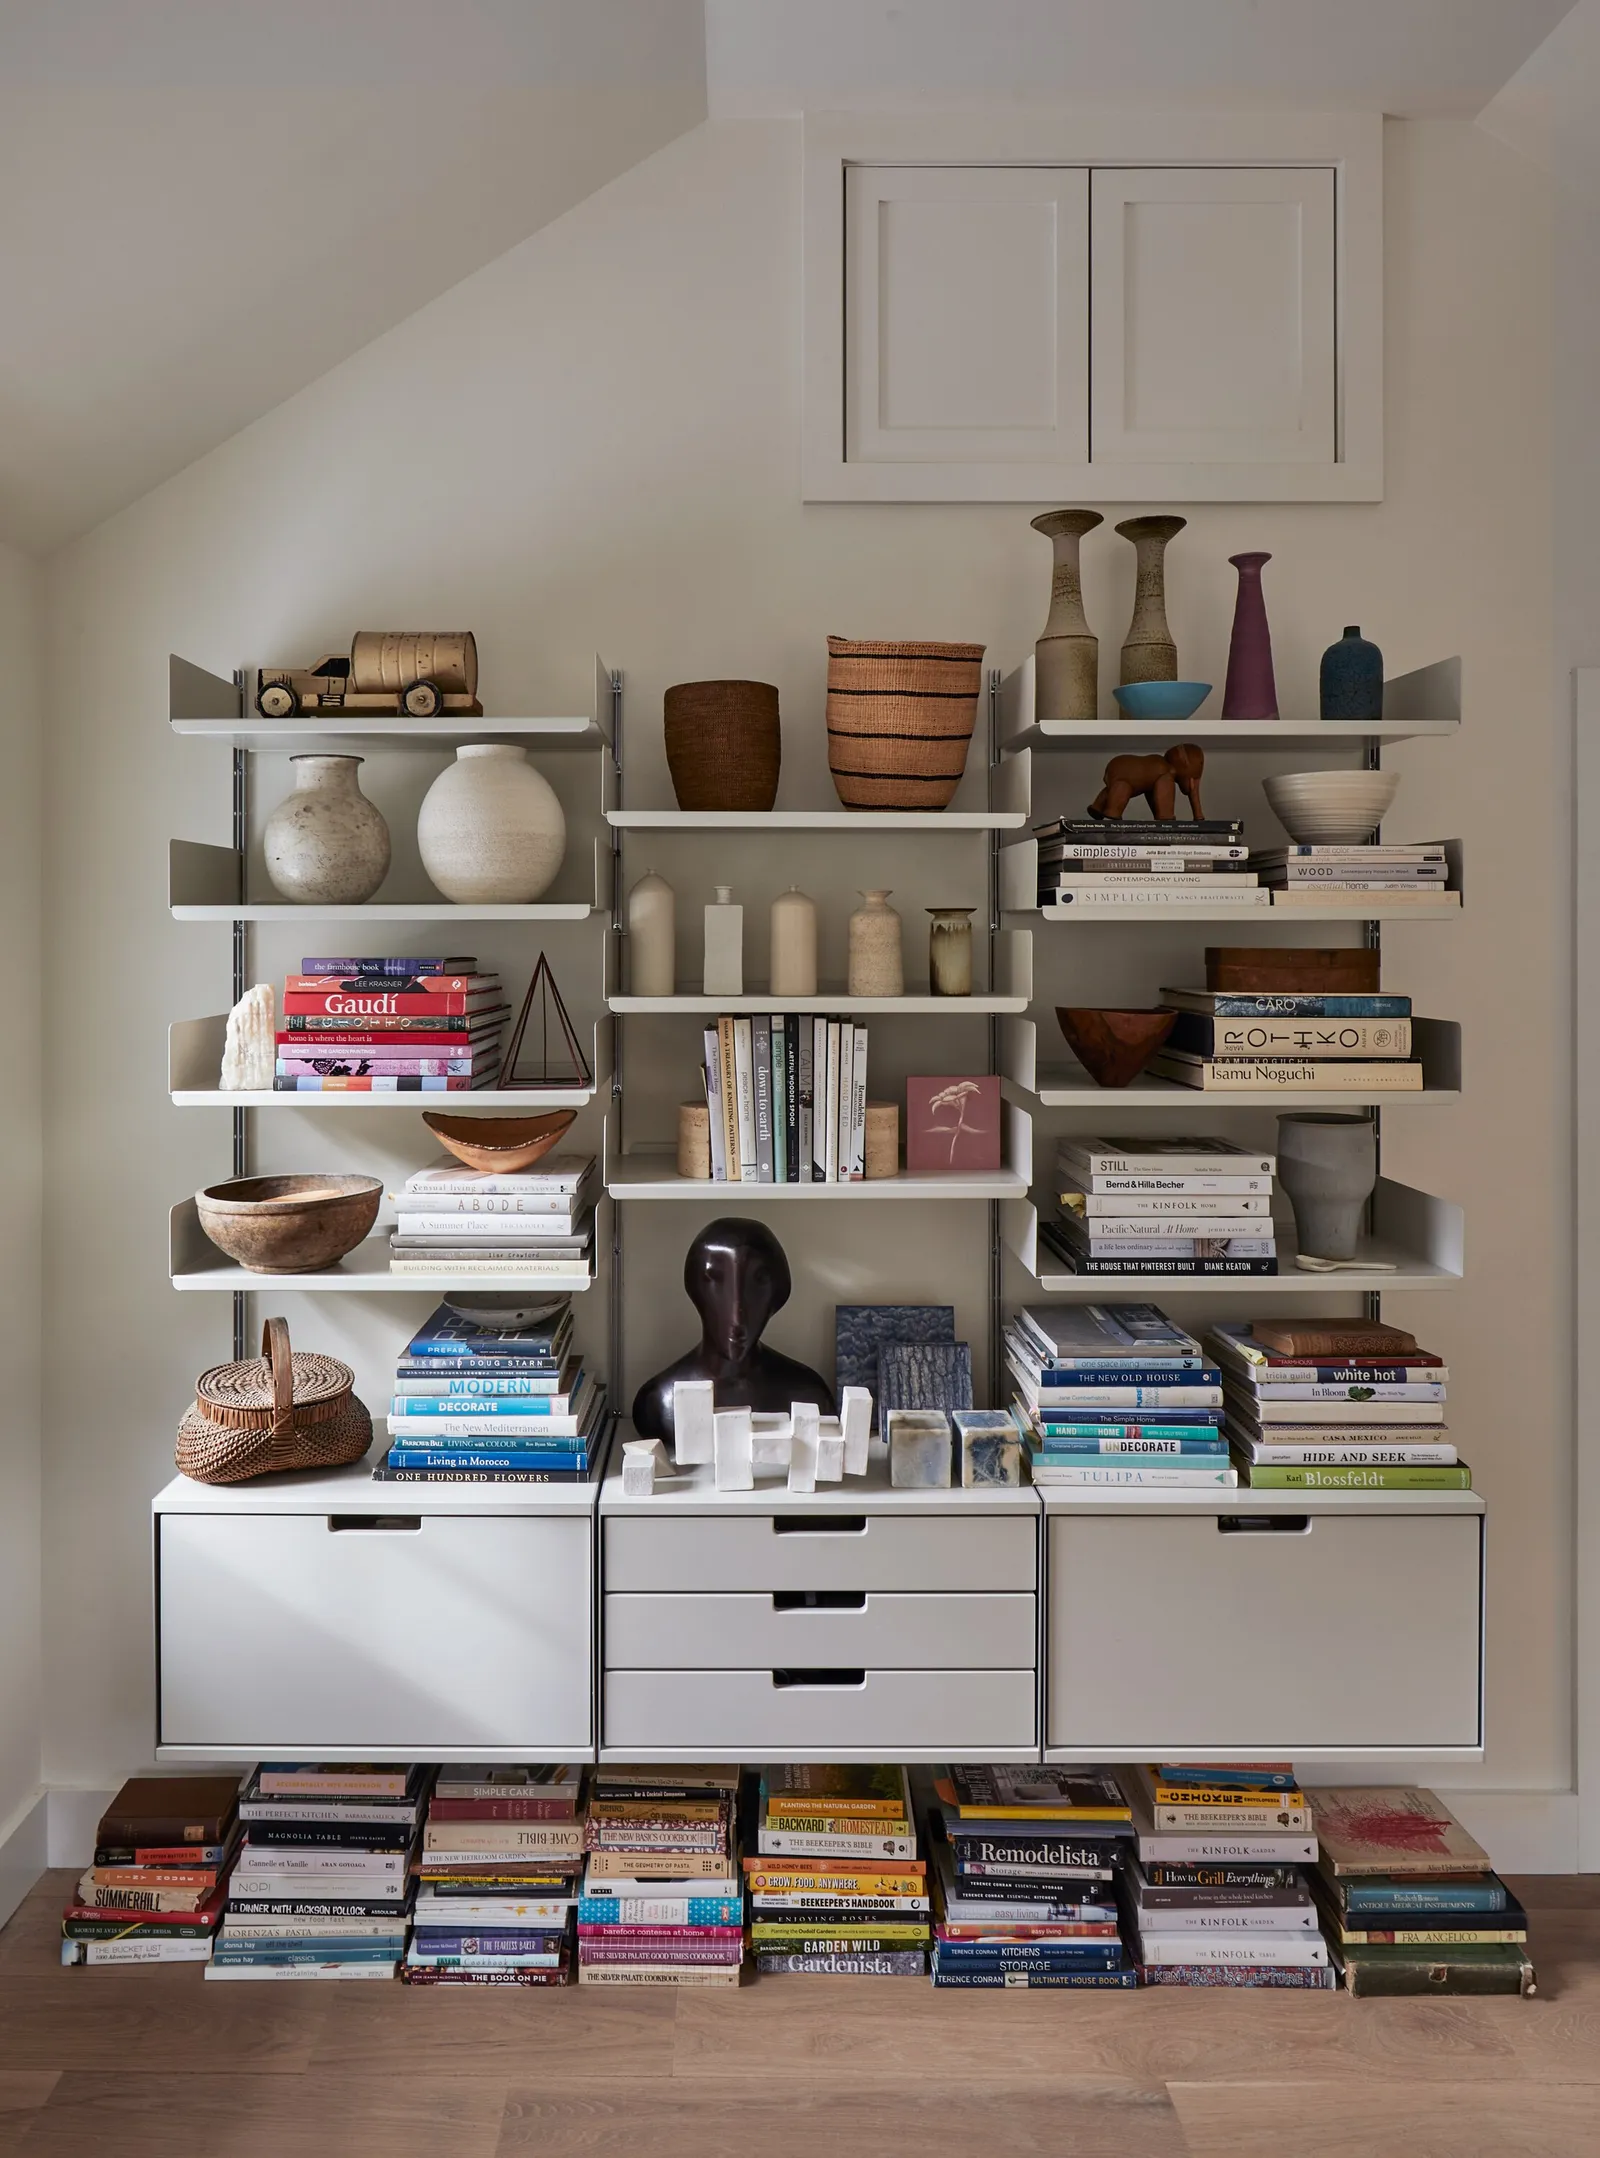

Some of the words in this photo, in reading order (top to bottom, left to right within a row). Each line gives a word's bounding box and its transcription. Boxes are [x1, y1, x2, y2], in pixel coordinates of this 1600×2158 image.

[1073, 847, 1137, 858] simplestyle
[1298, 868, 1333, 876] WOOD
[1085, 894, 1170, 902] SIMPLICITY
[325, 993, 399, 1013] Gaudí
[1255, 999, 1296, 1012] CARO
[800, 1048, 811, 1086] CALM
[1211, 1066, 1252, 1080] Isamu
[1256, 1066, 1314, 1083] Noguchi
[758, 1066, 769, 1096] down
[758, 1097, 767, 1106] to
[760, 1106, 770, 1141] earth
[1100, 1161, 1128, 1171] STILL
[458, 1199, 524, 1211] ABODE
[419, 1221, 425, 1229] A
[429, 1221, 463, 1229] Summer
[467, 1221, 489, 1229] Place
[1123, 1262, 1139, 1270] THAT
[1141, 1263, 1176, 1271] PINTEREST
[1177, 1262, 1195, 1270] BUILT
[1205, 1263, 1224, 1271] DIANE
[1225, 1263, 1251, 1271] KEATON
[1079, 1374, 1094, 1382] THE
[1098, 1374, 1119, 1382] NEW
[1121, 1374, 1142, 1382] OLD
[1147, 1374, 1180, 1382] HOUSE
[1290, 1372, 1311, 1381] guild
[1333, 1371, 1370, 1381] white
[1374, 1369, 1396, 1381] hot
[449, 1380, 531, 1393] MODERN
[1321, 1388, 1346, 1396] Bloom
[439, 1402, 497, 1411] DECORATE
[1113, 1416, 1134, 1424] Simple
[463, 1424, 481, 1432] New
[484, 1424, 549, 1433] Mediterranean
[427, 1456, 456, 1467] Living
[470, 1457, 509, 1466] Morocco
[1303, 1453, 1336, 1462] HIDE
[1341, 1453, 1367, 1462] AND
[1372, 1452, 1406, 1461] SEEK
[396, 1473, 421, 1481] ONE
[427, 1473, 487, 1481] HUNDRED
[495, 1474, 549, 1482] FLOWERS
[1080, 1471, 1143, 1482] TULIPA
[1286, 1474, 1302, 1482] Karl
[1305, 1472, 1385, 1486] Blossfeldt
[474, 1788, 507, 1796] SIMPLE
[509, 1788, 534, 1796] CAKE
[247, 1810, 263, 1818] THE
[265, 1810, 298, 1818] PERFECT
[1184, 1813, 1199, 1821] THE
[779, 1818, 824, 1830] BACKYARD
[841, 1822, 893, 1834] HOMESTEAD
[789, 1839, 804, 1847] THE
[806, 1840, 853, 1848] BEEKEEPER'S
[854, 1841, 873, 1849] BIBLE
[980, 1843, 1099, 1866] Remodelista
[1202, 1846, 1250, 1855] KINFOLK
[1166, 1872, 1187, 1882] How
[1187, 1873, 1197, 1882] to
[1198, 1870, 1224, 1885] Grill
[1226, 1872, 1275, 1888] Everything
[238, 1883, 270, 1892] NOPI
[95, 1888, 161, 1912] SUMMERHILL
[240, 1903, 269, 1913] DINNER
[272, 1904, 292, 1914] WITH
[293, 1905, 330, 1915] JACKSON
[332, 1906, 366, 1916] POLLOCK
[1200, 1918, 1248, 1926] KINFOLK
[228, 1929, 280, 1937] LORENZA'S
[683, 1928, 705, 1936] home
[1402, 1933, 1419, 1942] FRA
[1424, 1933, 1477, 1942] ANGELICO
[112, 1945, 143, 1953] BUCKET
[804, 1941, 848, 1953] GARDEN
[852, 1940, 880, 1951] WILD
[1001, 1947, 1040, 1957] KITCHENS
[243, 1956, 254, 1964] hay
[288, 1954, 315, 1962] classics
[788, 1955, 893, 1974] Gardenista
[999, 1961, 1050, 1971] STORAGE
[491, 1974, 516, 1982] BOOK
[587, 1973, 599, 1981] THE
[600, 1973, 620, 1981] SILVER
[621, 1974, 644, 1982] PALATE
[645, 1974, 679, 1982] COOKBOOK
[938, 1975, 970, 1983] TERENCE
[1033, 1976, 1069, 1984] ULTIMATE
